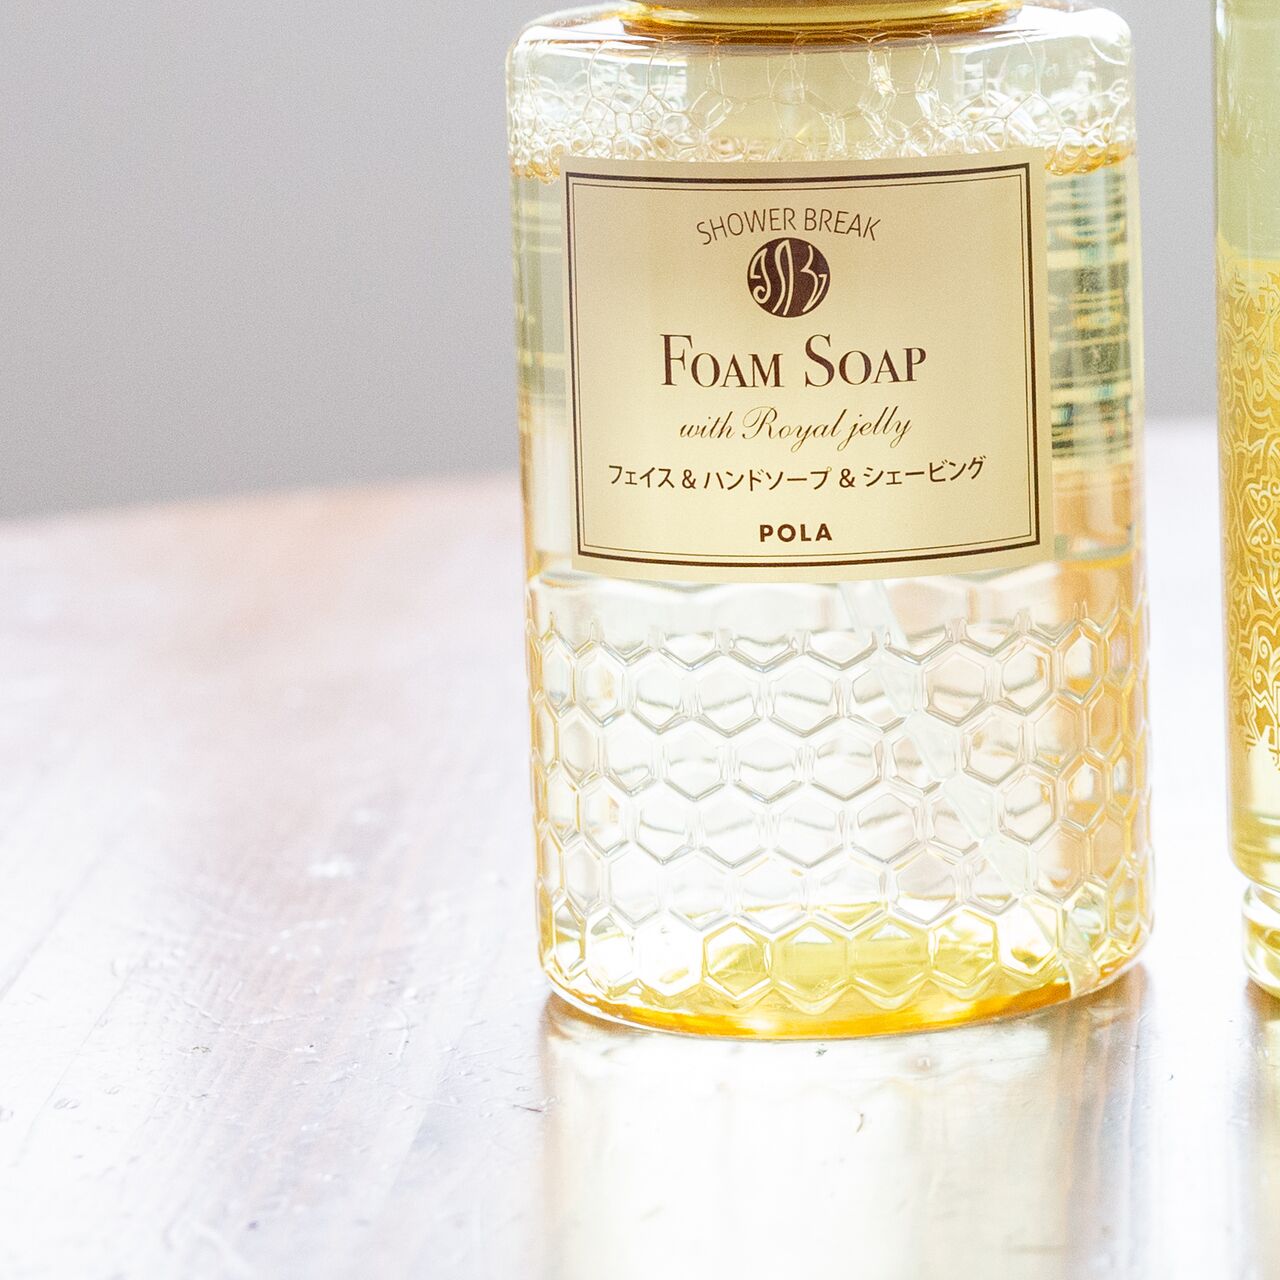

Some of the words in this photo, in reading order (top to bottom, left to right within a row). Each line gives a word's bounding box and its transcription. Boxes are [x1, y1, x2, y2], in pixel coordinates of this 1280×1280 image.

[696, 207, 797, 245] SHOWER
[804, 207, 882, 241] BREAK
[679, 411, 736, 439] with
[742, 406, 843, 452] Royal
[837, 405, 913, 454] jelly
[759, 523, 833, 543] POLA
